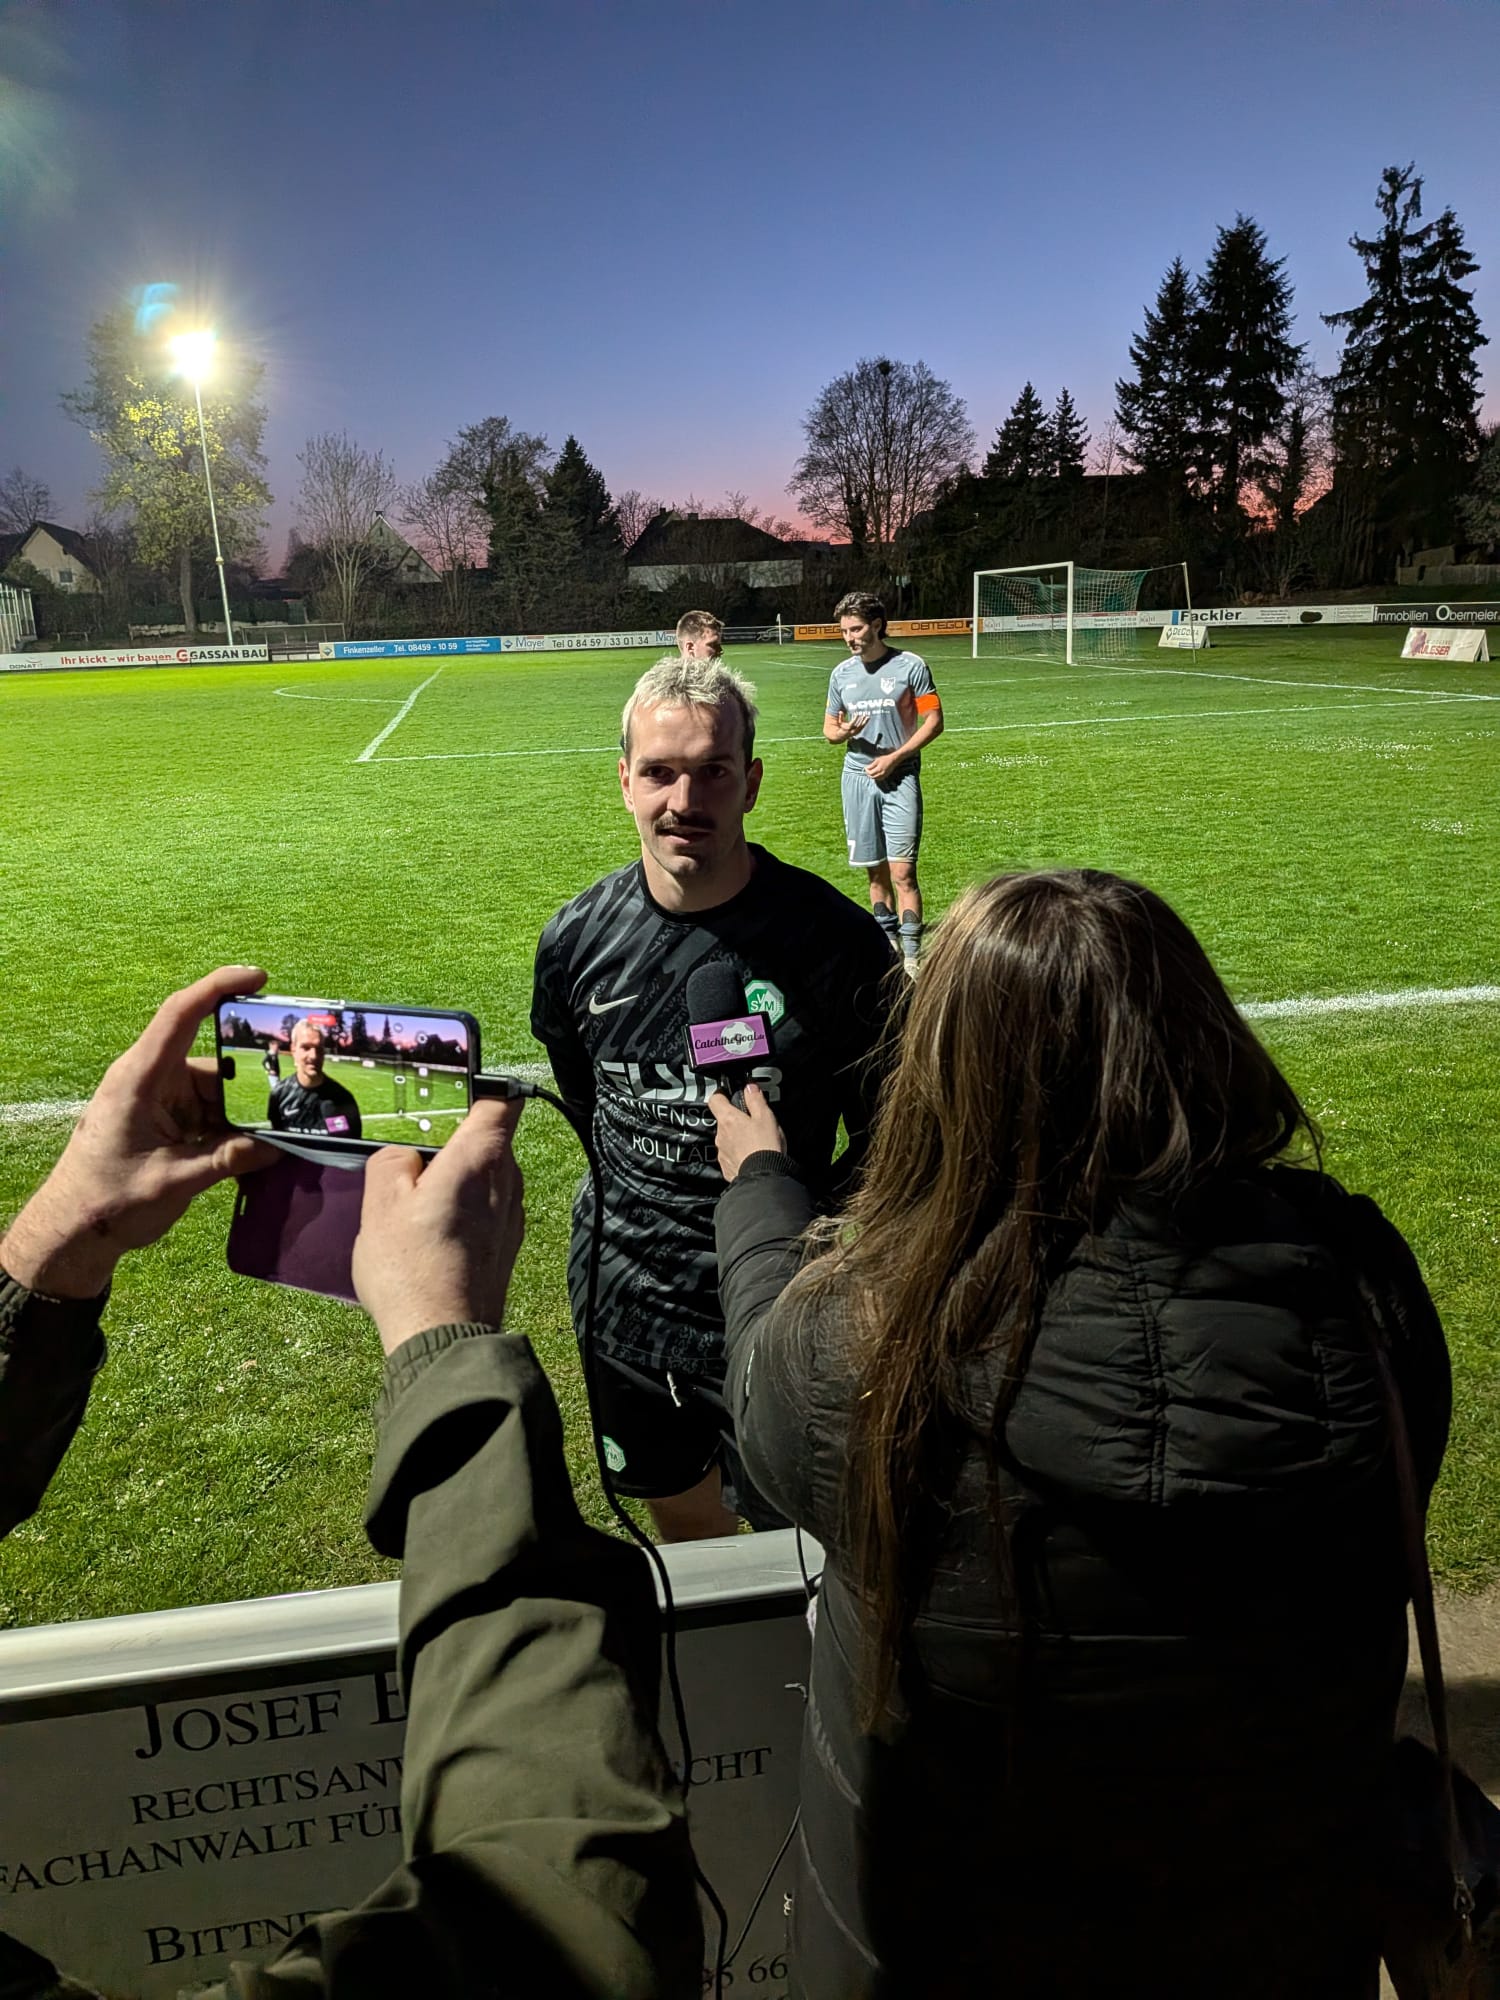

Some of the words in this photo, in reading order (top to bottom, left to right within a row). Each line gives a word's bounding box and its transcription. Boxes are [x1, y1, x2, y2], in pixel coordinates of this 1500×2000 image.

[1180, 610, 1242, 622] Fackler
[1374, 607, 1429, 621] Immobilien
[1436, 605, 1498, 621] Obermeier
[343, 646, 385, 654] Finkenzeller
[393, 644, 406, 652] Tel.
[408, 643, 431, 651] 08459
[448, 642, 458, 650] 59
[515, 637, 545, 649] Mayer
[552, 640, 565, 648] Tel
[567, 639, 574, 648] 0
[575, 639, 587, 648] 84
[590, 638, 601, 647] 59
[609, 637, 622, 646] 33
[623, 636, 634, 645] 01
[637, 636, 649, 645] 34
[60, 656, 76, 665] Ihr
[78, 655, 107, 664] kickt
[117, 655, 134, 663] wir
[190, 650, 239, 660] GASSAN
[242, 648, 267, 658] BAU
[135, 1688, 343, 1760] JOSEF
[747, 1953, 791, 1984] 66
